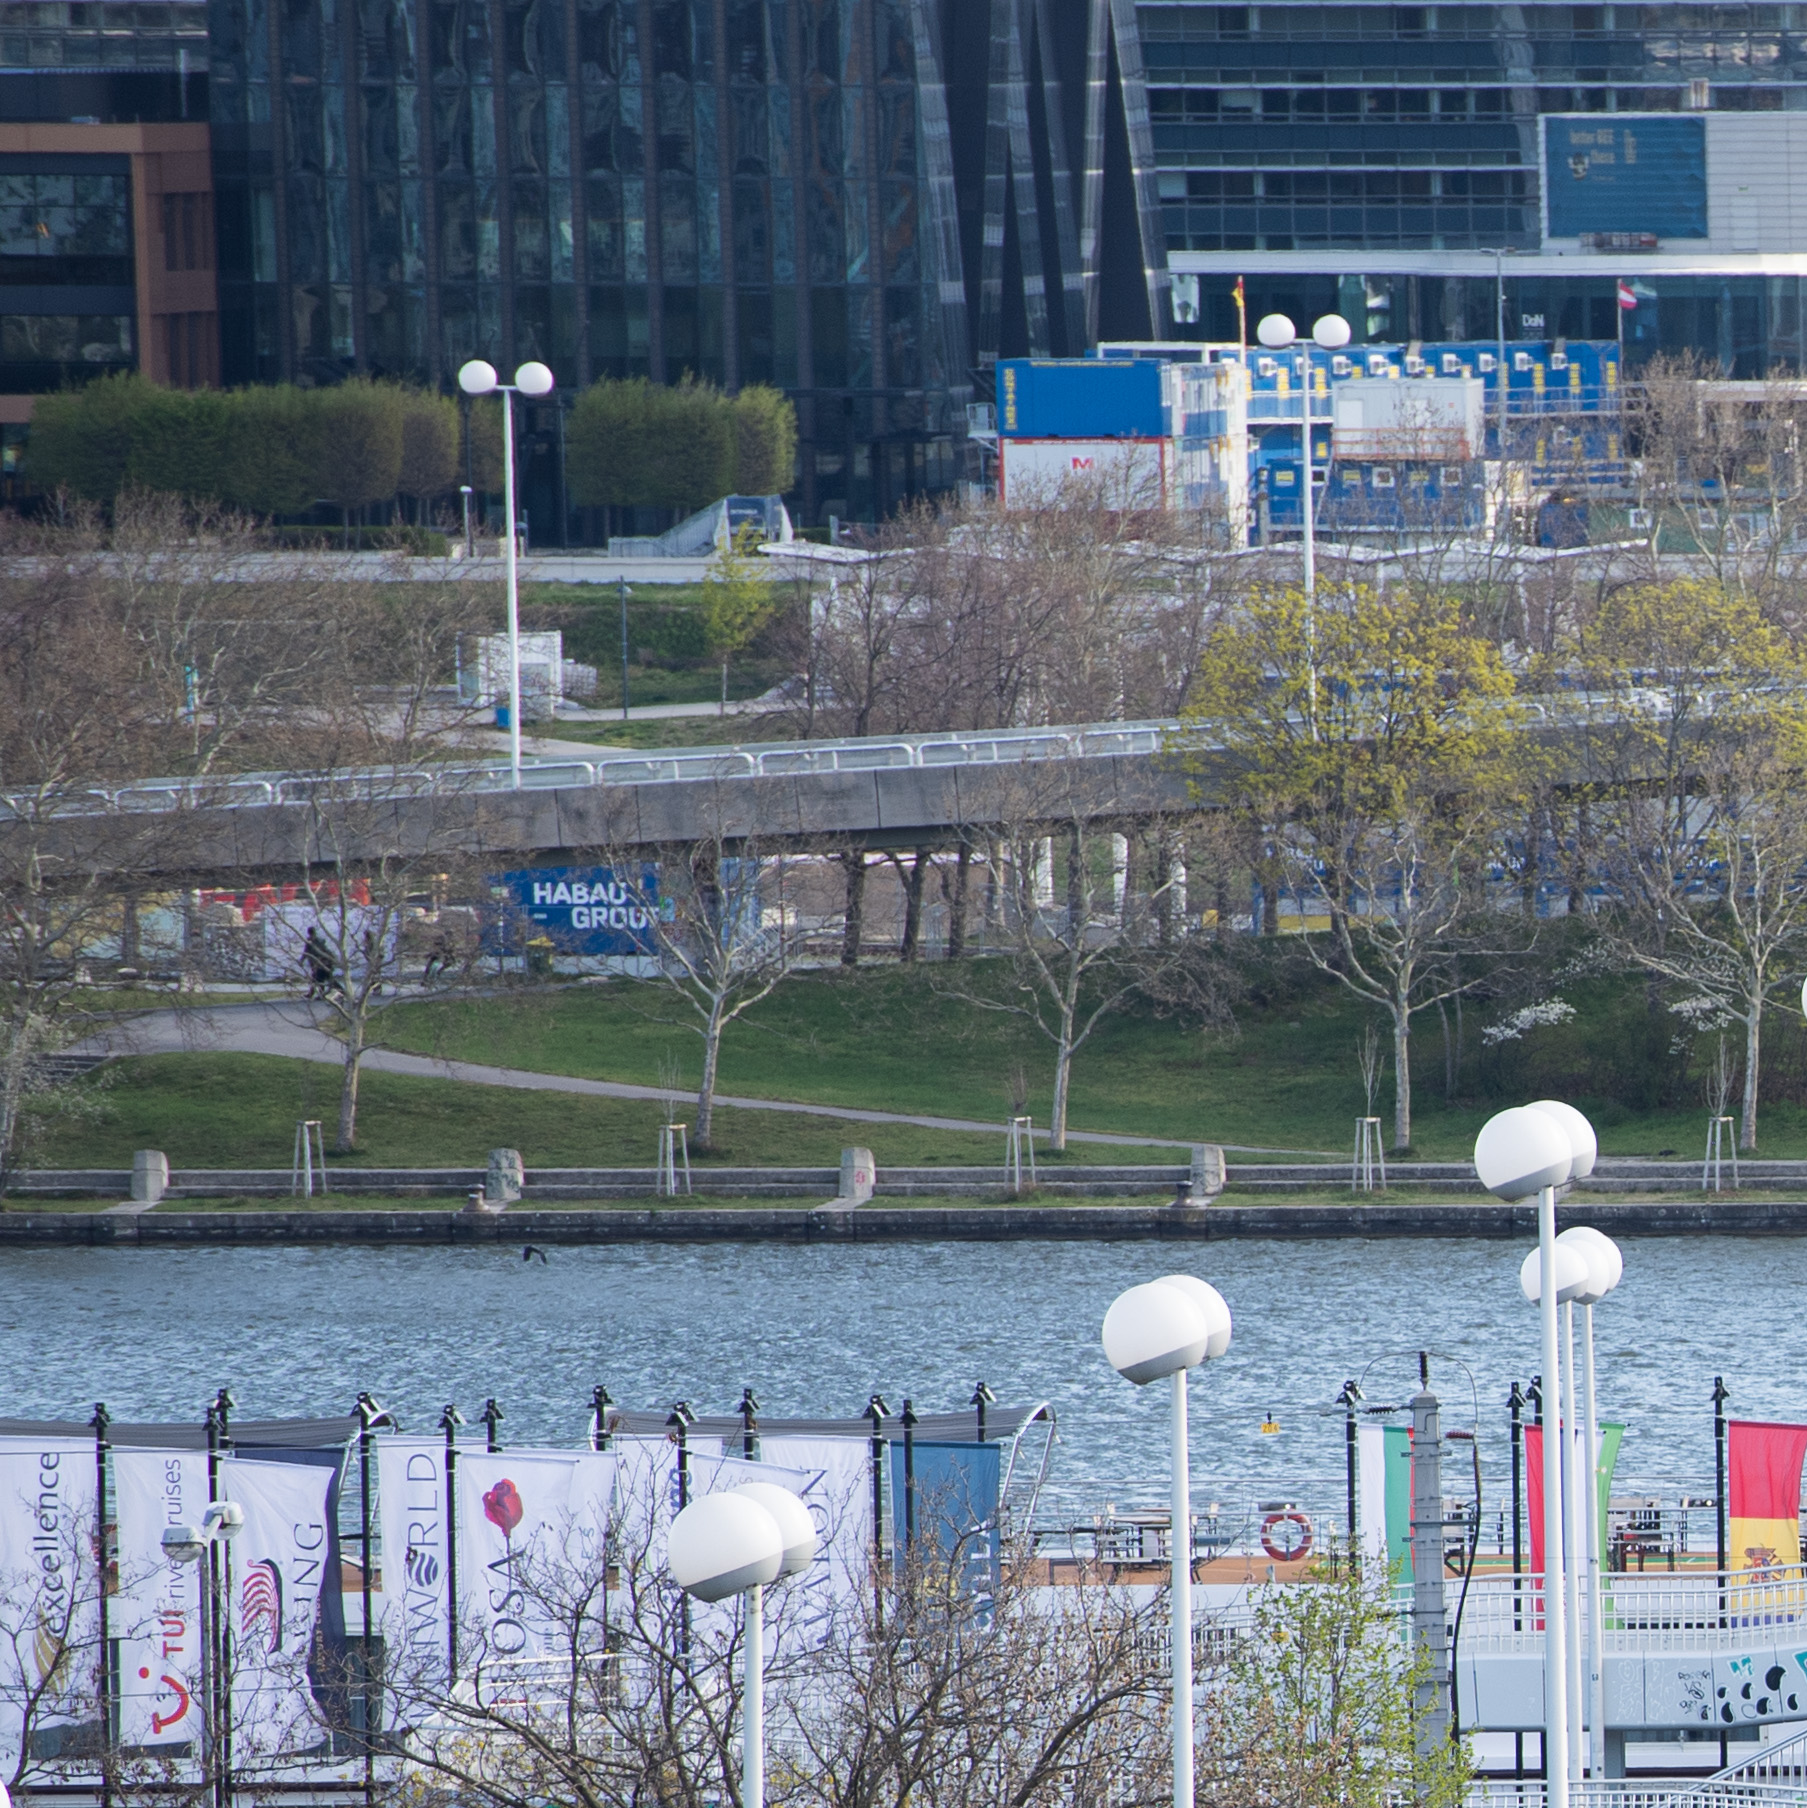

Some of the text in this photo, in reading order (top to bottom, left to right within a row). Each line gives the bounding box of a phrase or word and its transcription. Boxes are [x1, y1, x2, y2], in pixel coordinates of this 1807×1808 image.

[533, 882, 628, 905] HABAU
[33, 1452, 66, 1635] excellence
[163, 1459, 186, 1657] TUI rive ruises
